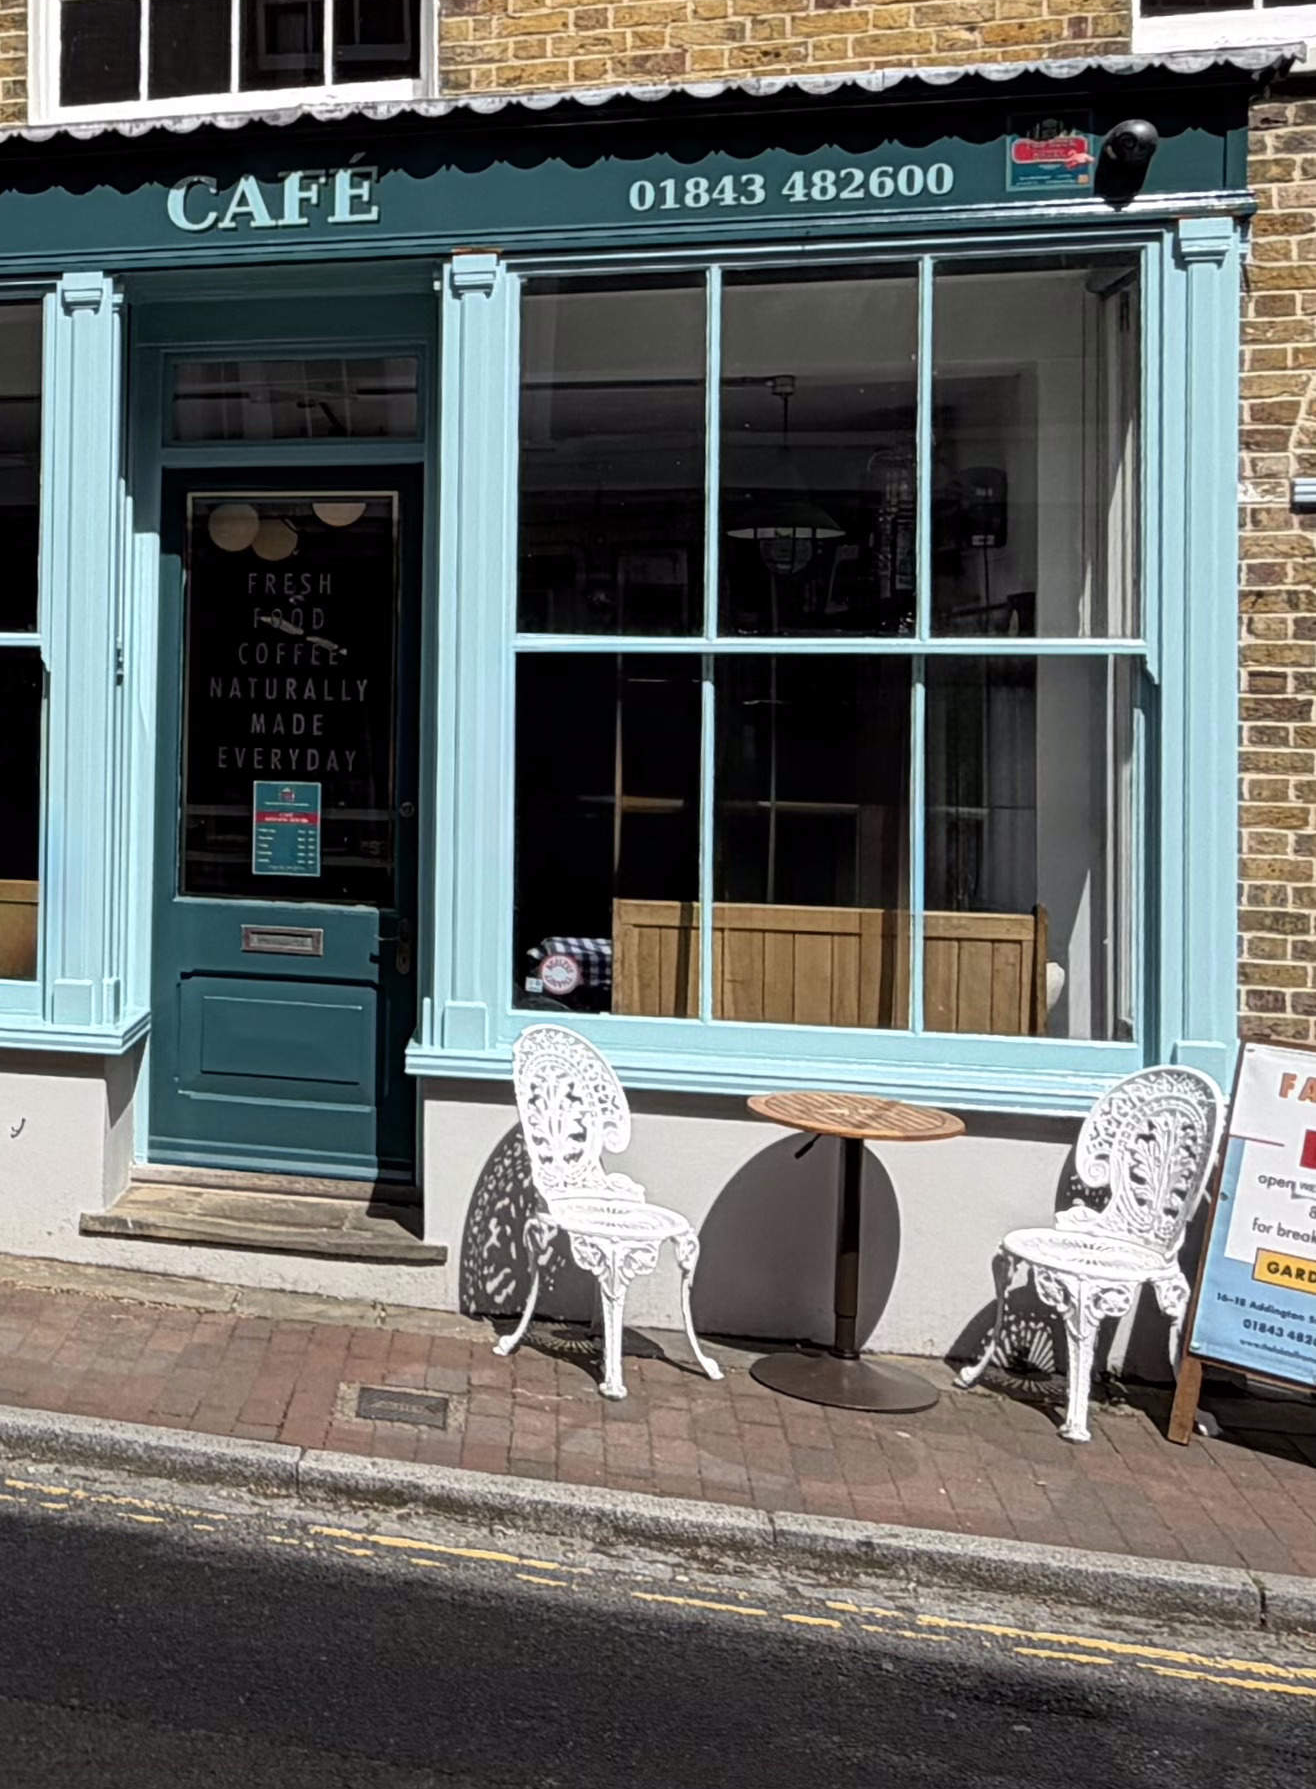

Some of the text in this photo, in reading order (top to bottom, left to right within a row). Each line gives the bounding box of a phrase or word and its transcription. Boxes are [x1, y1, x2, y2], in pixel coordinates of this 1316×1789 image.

[167, 152, 379, 232] CAFÉ
[629, 163, 955, 211] 01843 482600
[248, 573, 332, 594] FRESH
[254, 607, 324, 629] FOOD
[238, 643, 339, 665] COFFEE
[210, 676, 368, 702] NATURALLY
[250, 713, 324, 736] MADE
[218, 746, 356, 772] EVERYDAY
[1258, 1174, 1296, 1189] open
[1252, 1217, 1273, 1233] for
[1267, 1261, 1316, 1284] GARD
[1249, 1300, 1305, 1322] Addington
[1243, 1318, 1284, 1338] 01843
